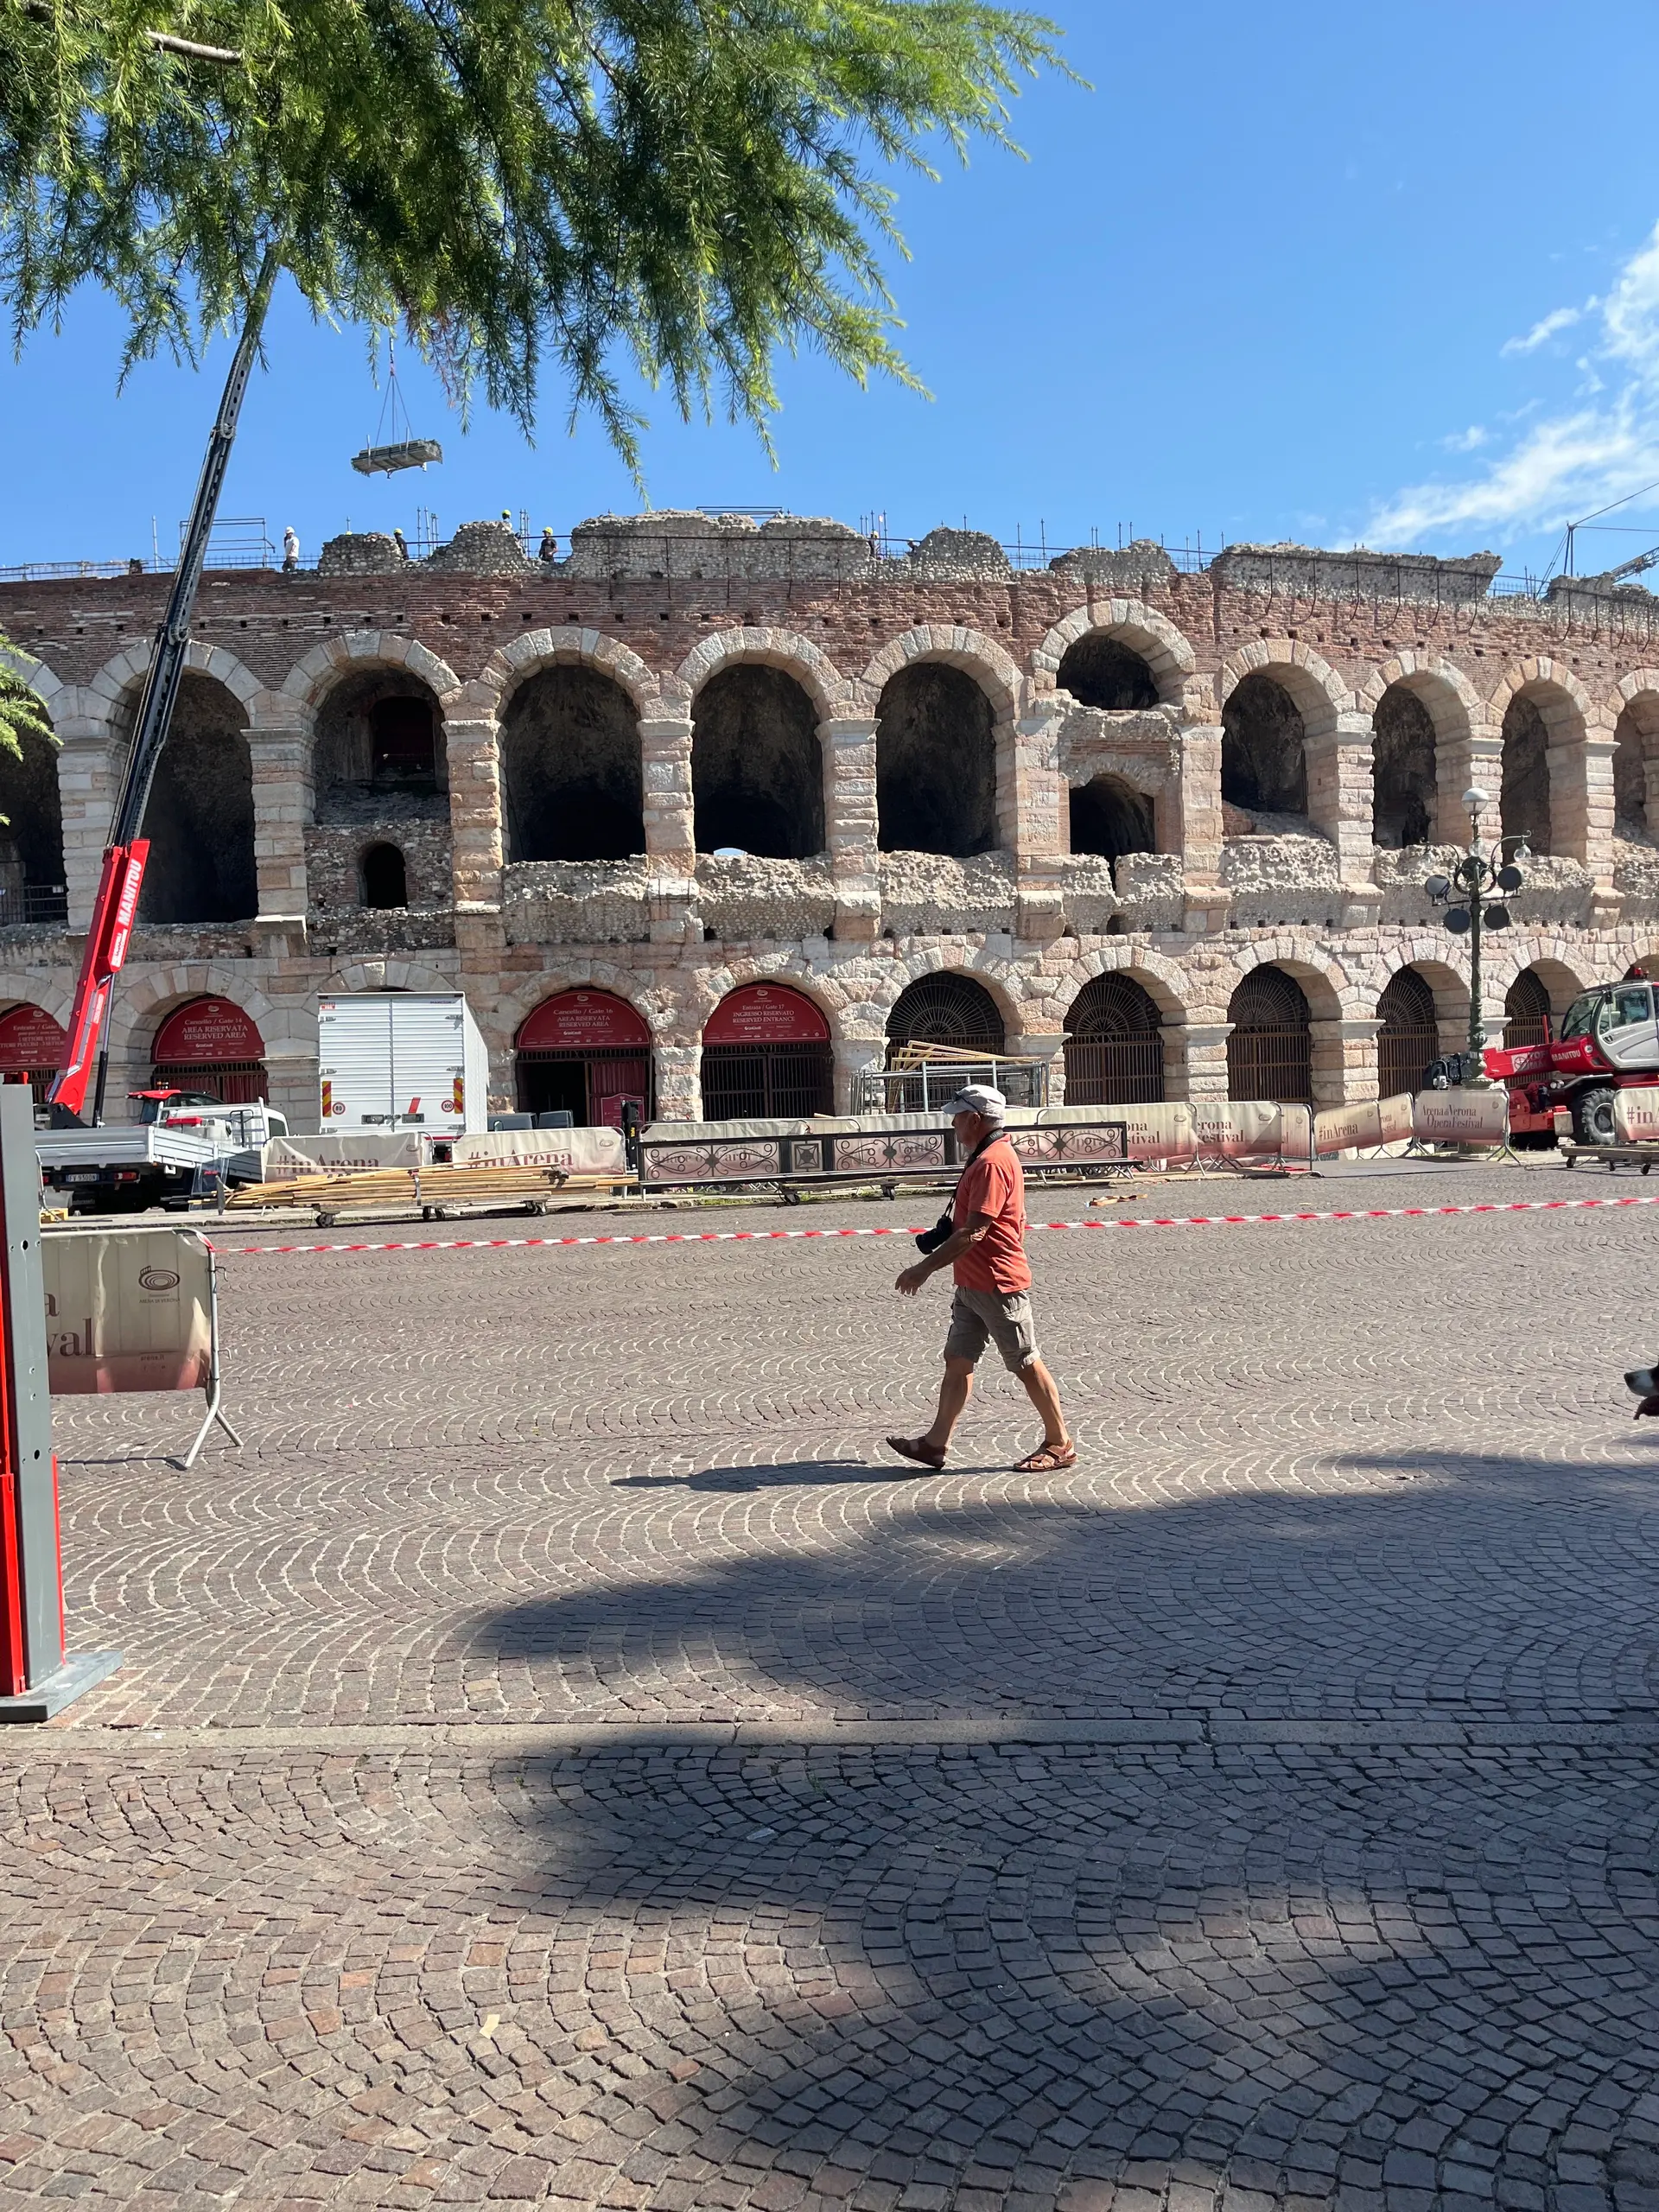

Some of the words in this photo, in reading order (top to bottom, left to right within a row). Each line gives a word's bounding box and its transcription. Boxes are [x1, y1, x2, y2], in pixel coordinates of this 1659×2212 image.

[118, 858, 143, 925] MANITOU
[1551, 1049, 1581, 1061] MANITOU
[1449, 1104, 1476, 1116] Verona
[1427, 1114, 1452, 1131] Opera
[1452, 1116, 1483, 1129] Festival
[1319, 1123, 1358, 1141] #inArena
[276, 1154, 379, 1174] #inArena
[467, 1148, 574, 1168] #inArena
